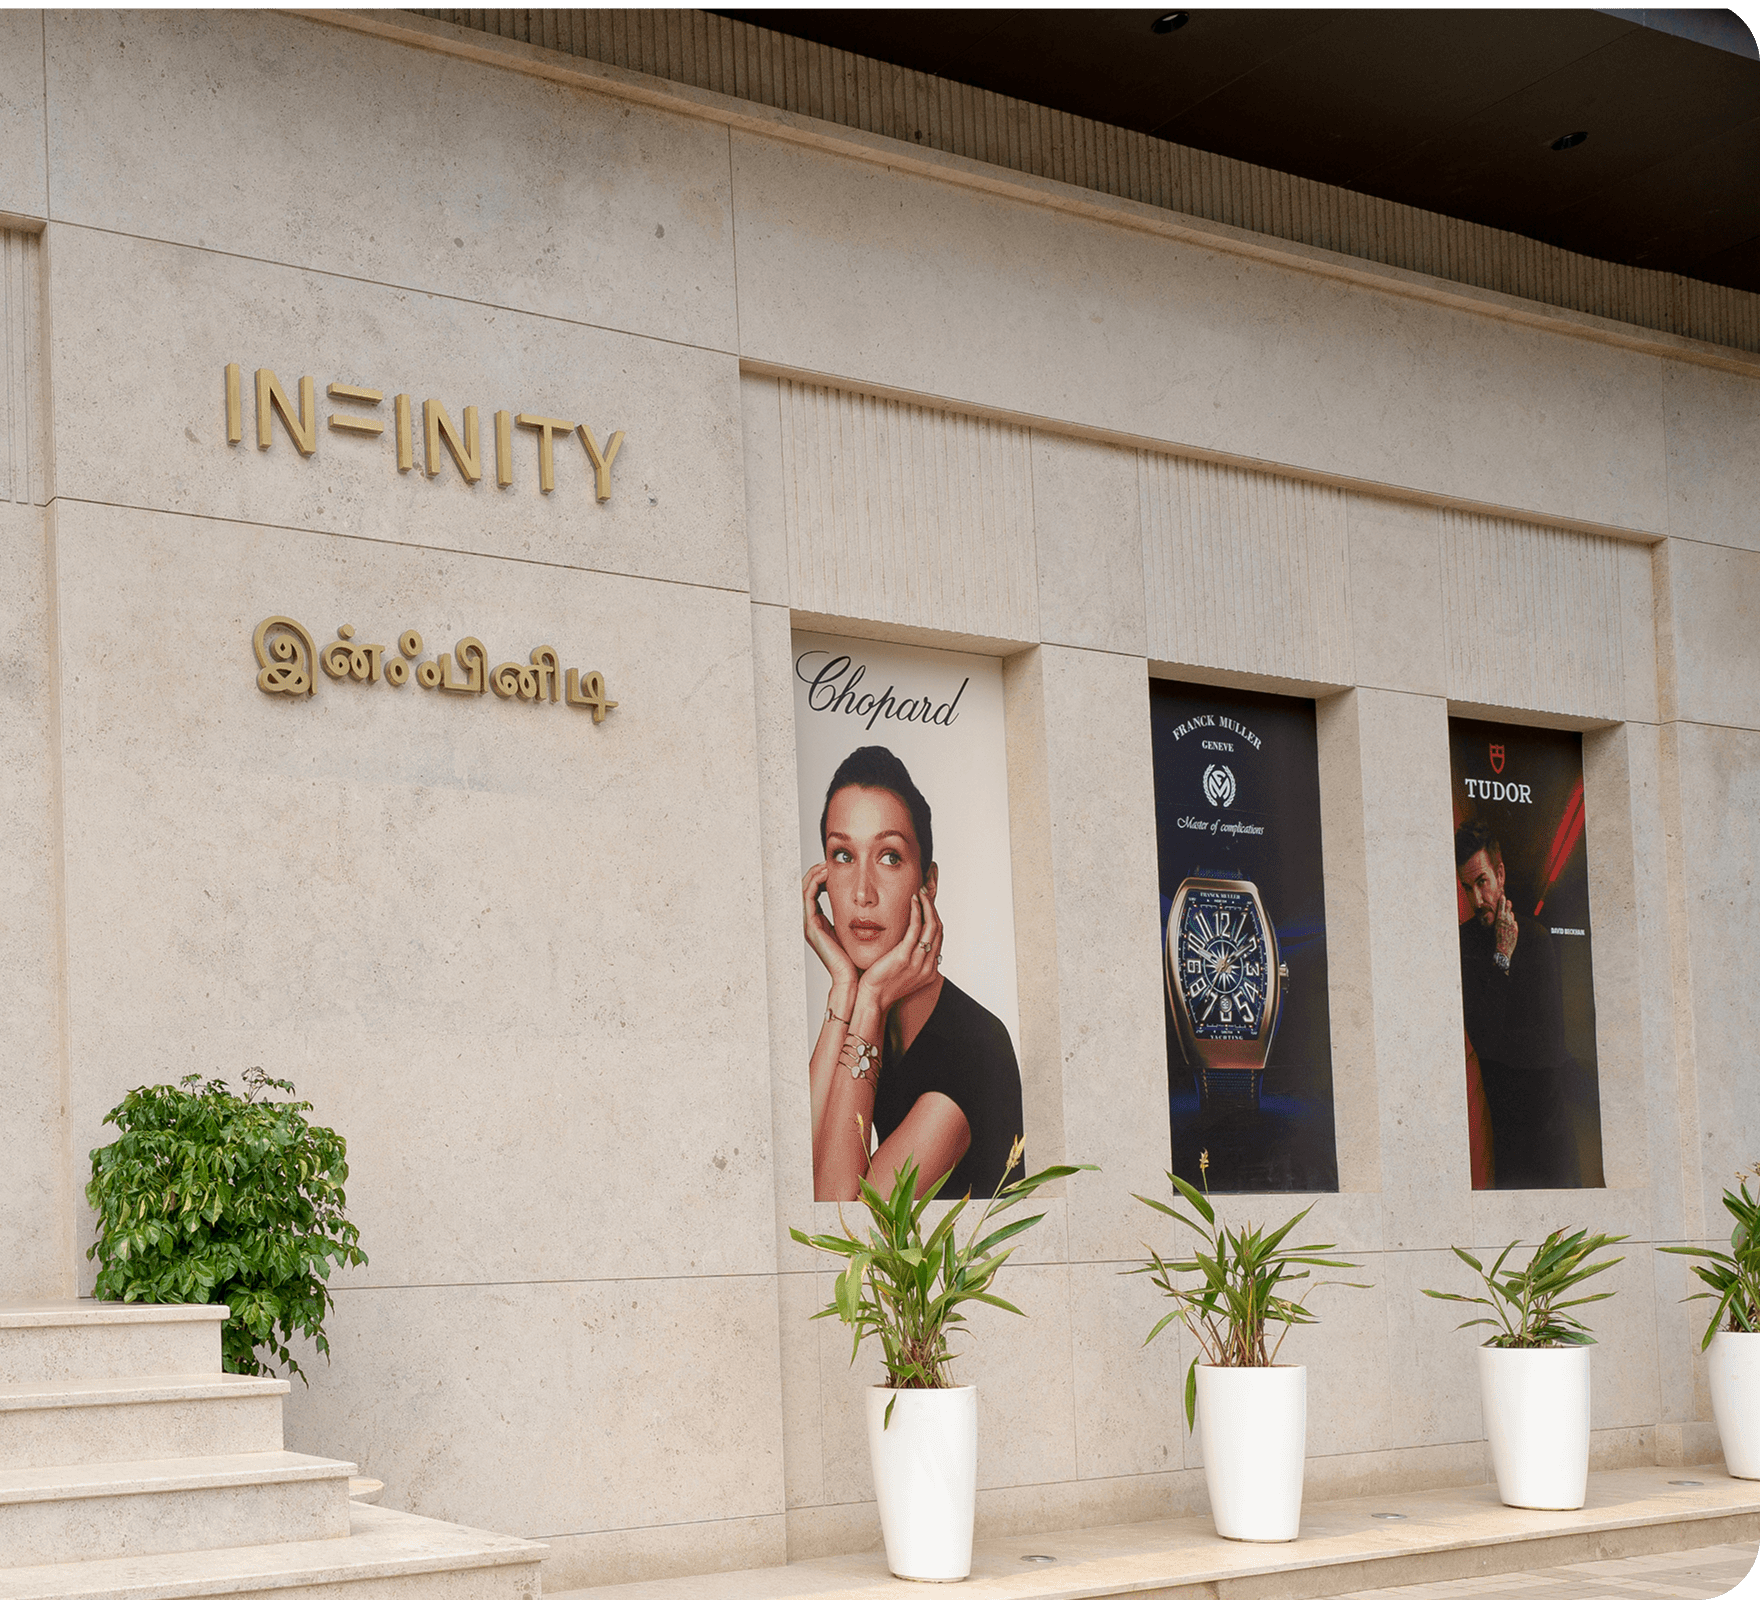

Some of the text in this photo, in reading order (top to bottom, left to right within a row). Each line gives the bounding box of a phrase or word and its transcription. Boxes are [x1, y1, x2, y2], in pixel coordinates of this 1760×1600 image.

[795, 650, 970, 731] Chopard
[1172, 715, 1261, 750] FRANCK MULLER
[1201, 740, 1234, 752] GENEVE
[1464, 778, 1533, 804] TUDOR
[1177, 816, 1264, 837] Master of complications
[1212, 910, 1231, 938] 12
